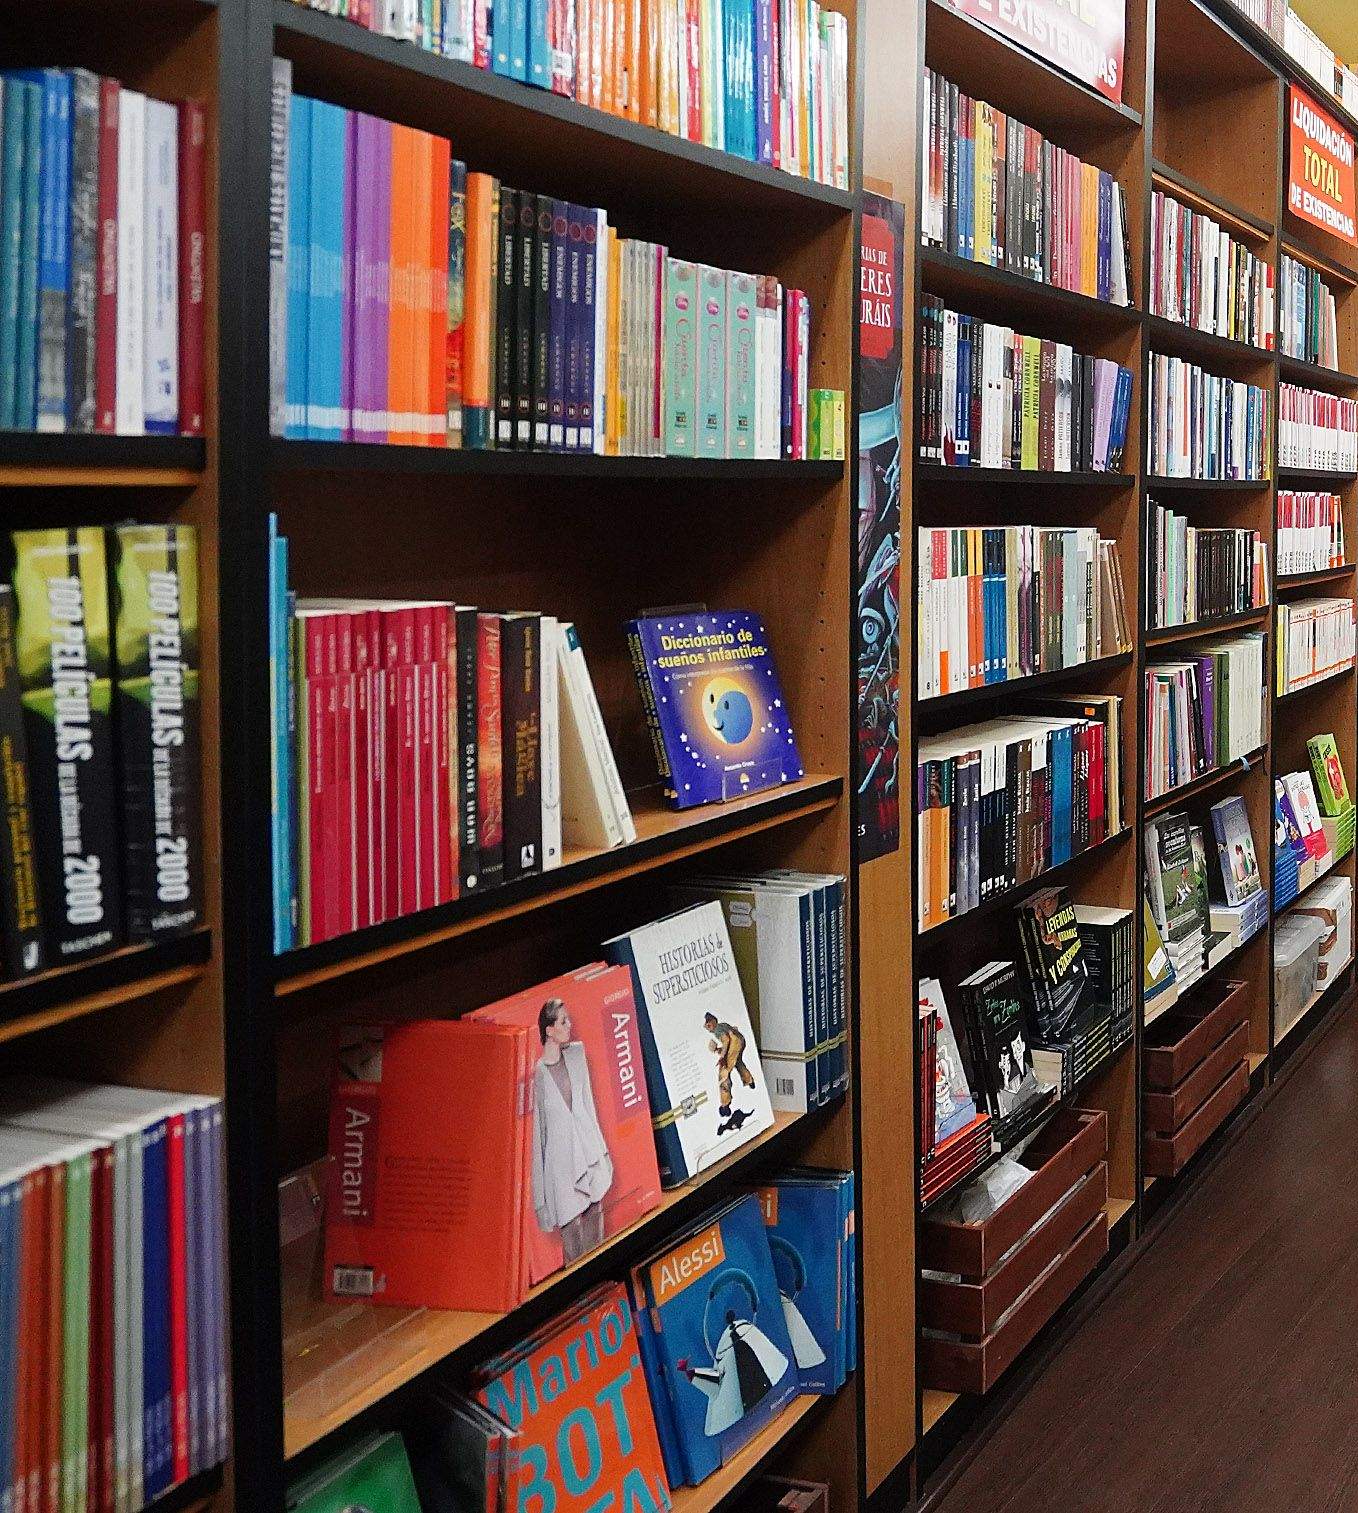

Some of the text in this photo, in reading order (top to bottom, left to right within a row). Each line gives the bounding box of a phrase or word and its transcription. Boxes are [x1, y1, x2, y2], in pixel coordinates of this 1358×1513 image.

[1293, 97, 1352, 167] LIQUIDACIÓN
[1303, 144, 1343, 203] TOTAL
[1291, 182, 1355, 238] DE EXISTENCIAS
[878, 250, 887, 265] DE
[47, 576, 82, 623] 100
[148, 571, 179, 613] 100
[657, 644, 765, 669] sueños infantiles
[660, 628, 753, 651] Diccionario de
[50, 625, 95, 762] PELÍCULAS
[148, 617, 188, 748] PELÍCULAS
[64, 854, 104, 926] 2000
[156, 835, 190, 902] 2000
[1045, 905, 1074, 934] LEYENDAS
[651, 951, 730, 1006] SUPERSTICIOSOS
[658, 933, 716, 974] HISTORIAS
[805, 920, 813, 984] SUPERSTICIOSOS
[610, 1012, 643, 1109] Armani
[341, 1106, 371, 1218] Armani
[658, 1232, 720, 1296] Alessi
[483, 1312, 623, 1429] Mario
